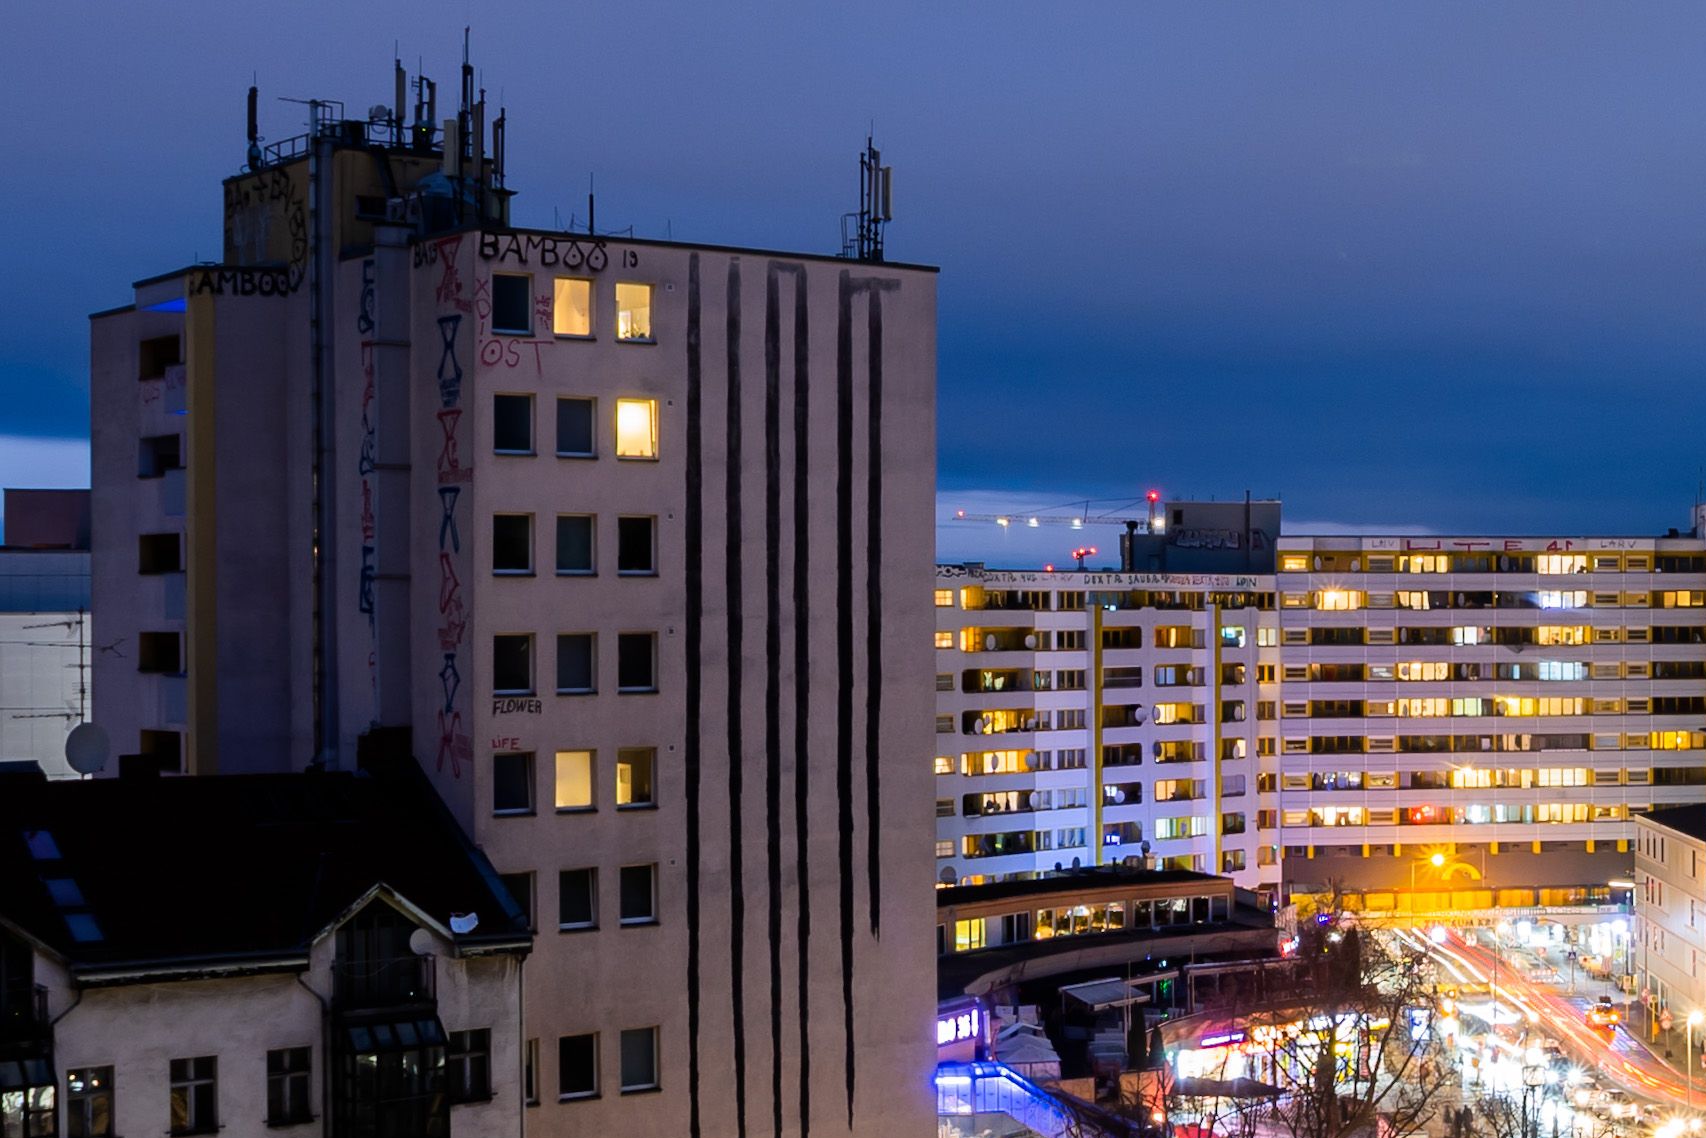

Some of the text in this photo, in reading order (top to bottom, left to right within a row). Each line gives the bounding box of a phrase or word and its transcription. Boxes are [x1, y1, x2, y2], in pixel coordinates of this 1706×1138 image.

[480, 231, 639, 272] BAMBOO 19
[492, 699, 542, 718] FLOWER
